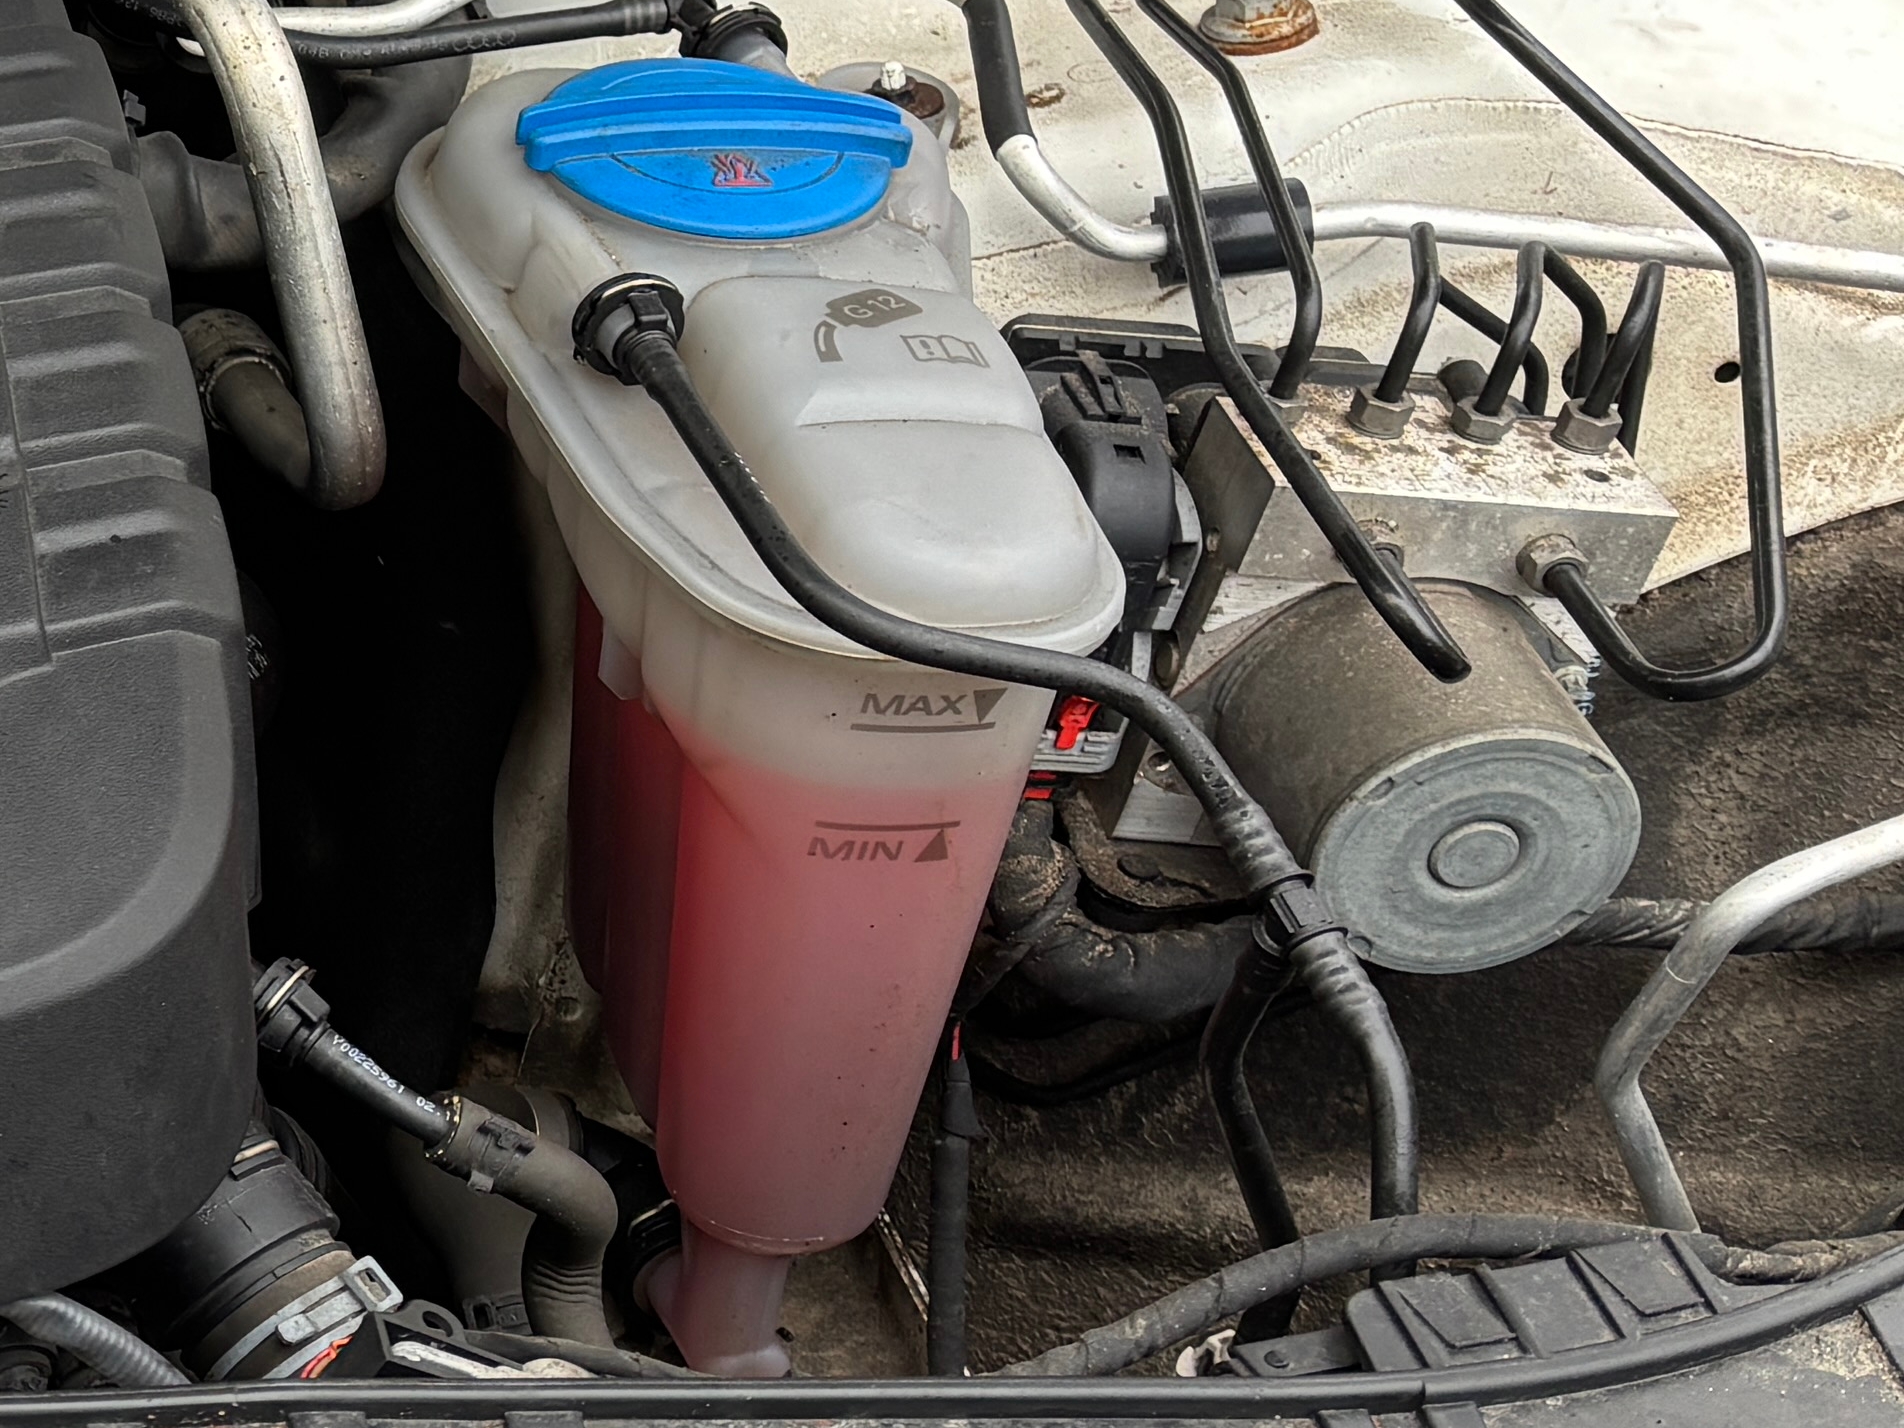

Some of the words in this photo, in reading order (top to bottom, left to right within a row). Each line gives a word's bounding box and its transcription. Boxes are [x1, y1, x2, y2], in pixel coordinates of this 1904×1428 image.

[860, 692, 967, 716] MAX
[807, 836, 904, 861] MIN
[332, 1034, 405, 1094] Y00225961
